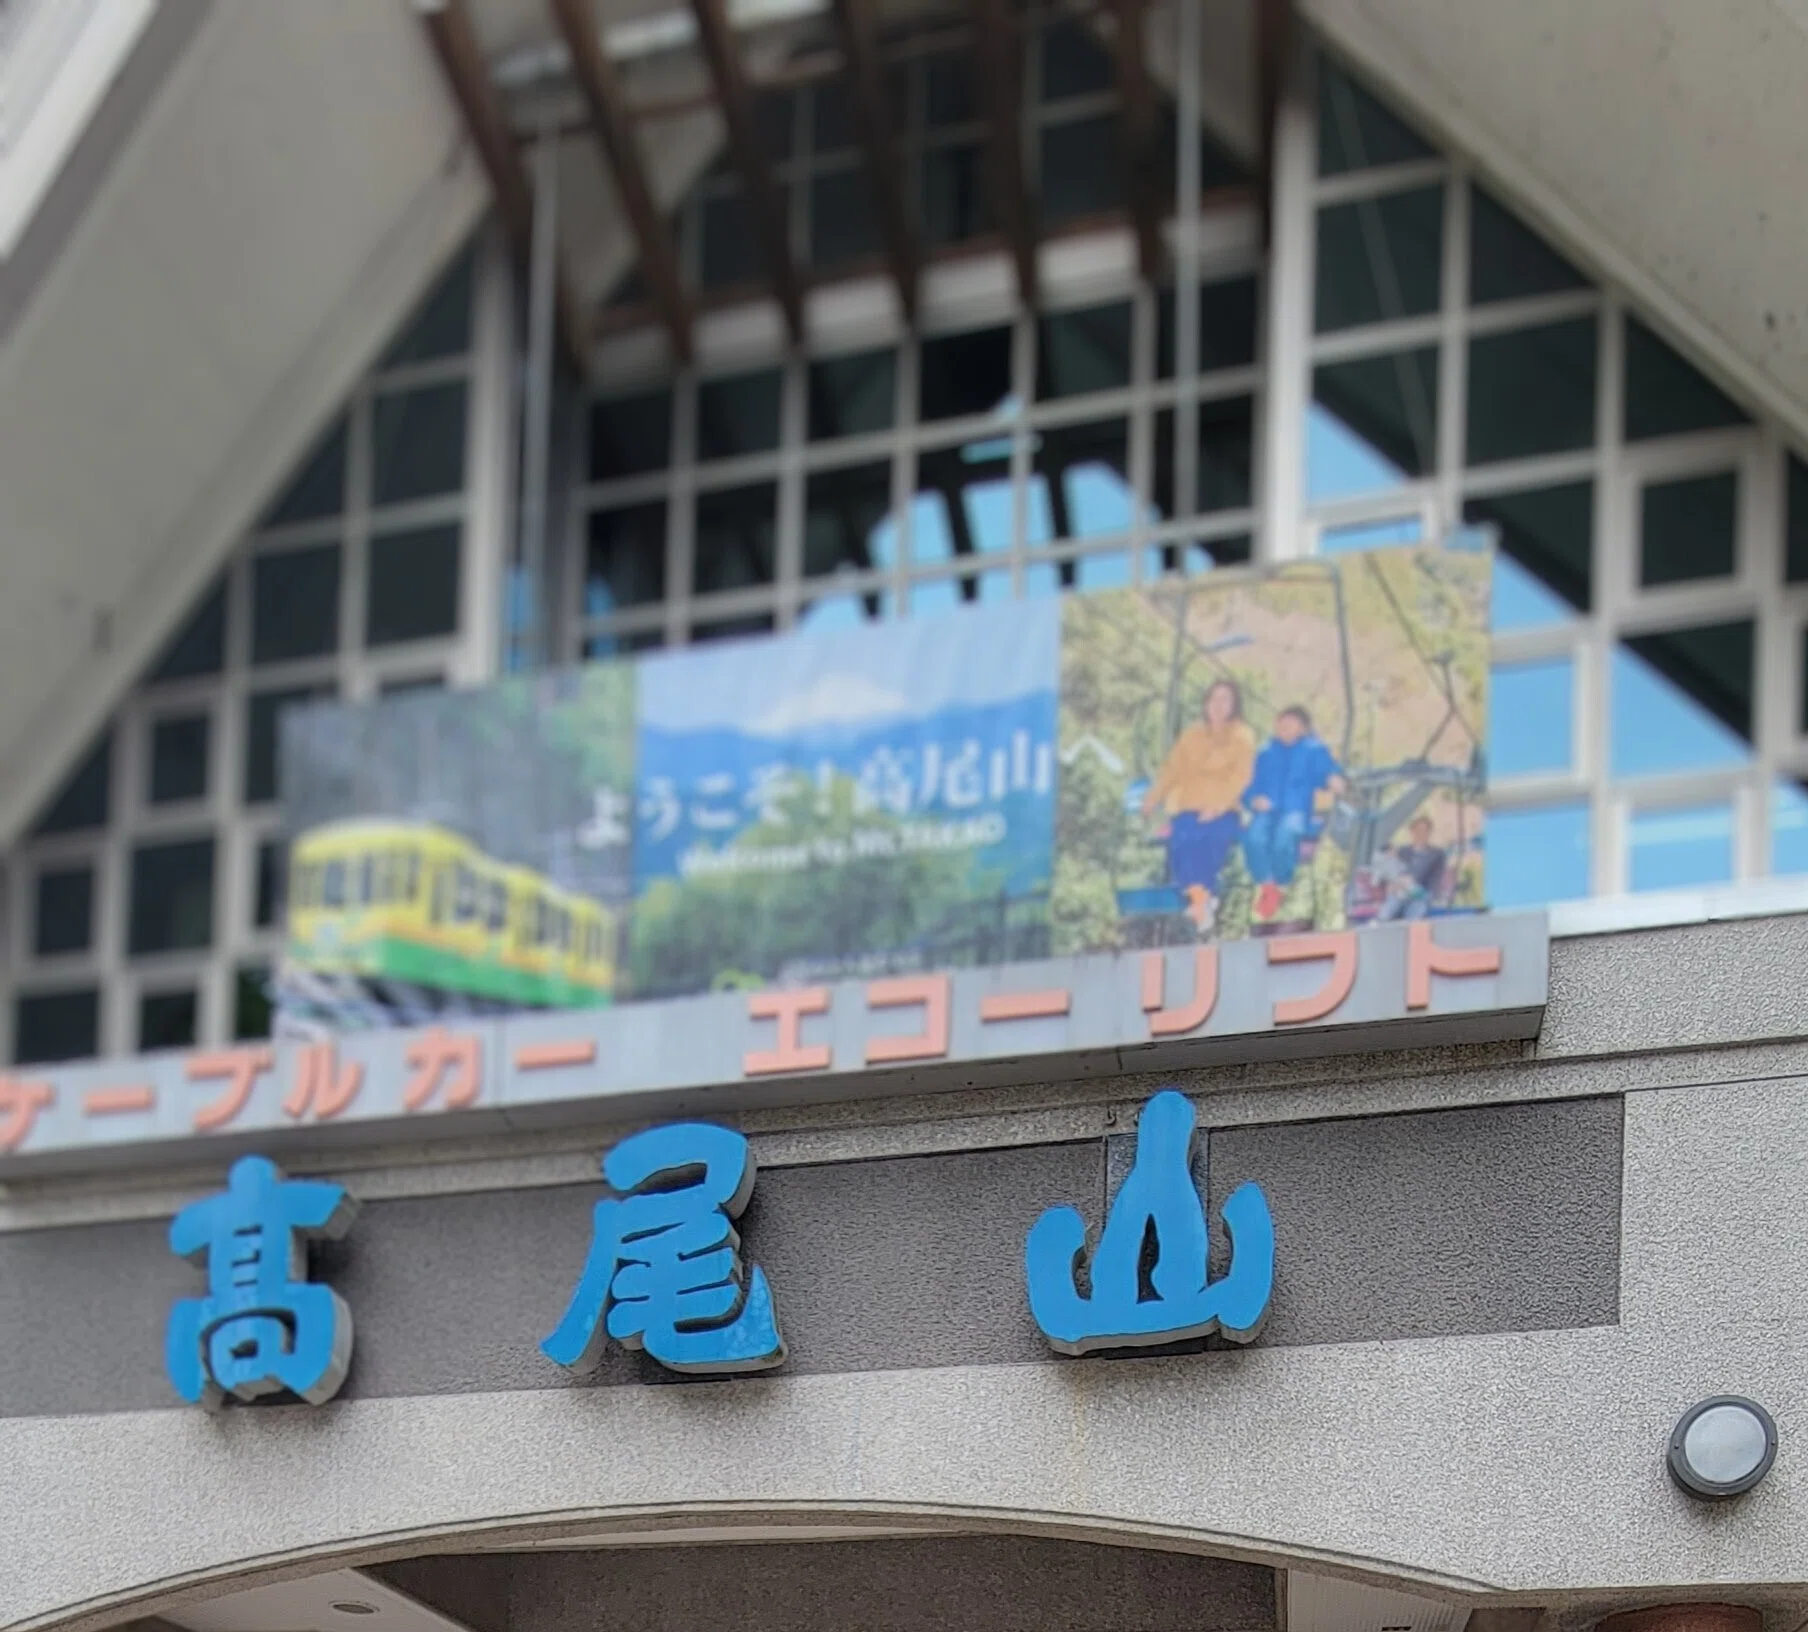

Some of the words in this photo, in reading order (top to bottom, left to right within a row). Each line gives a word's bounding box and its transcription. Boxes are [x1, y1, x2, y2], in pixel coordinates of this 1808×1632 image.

[744, 921, 1502, 1075] エコーリフト
